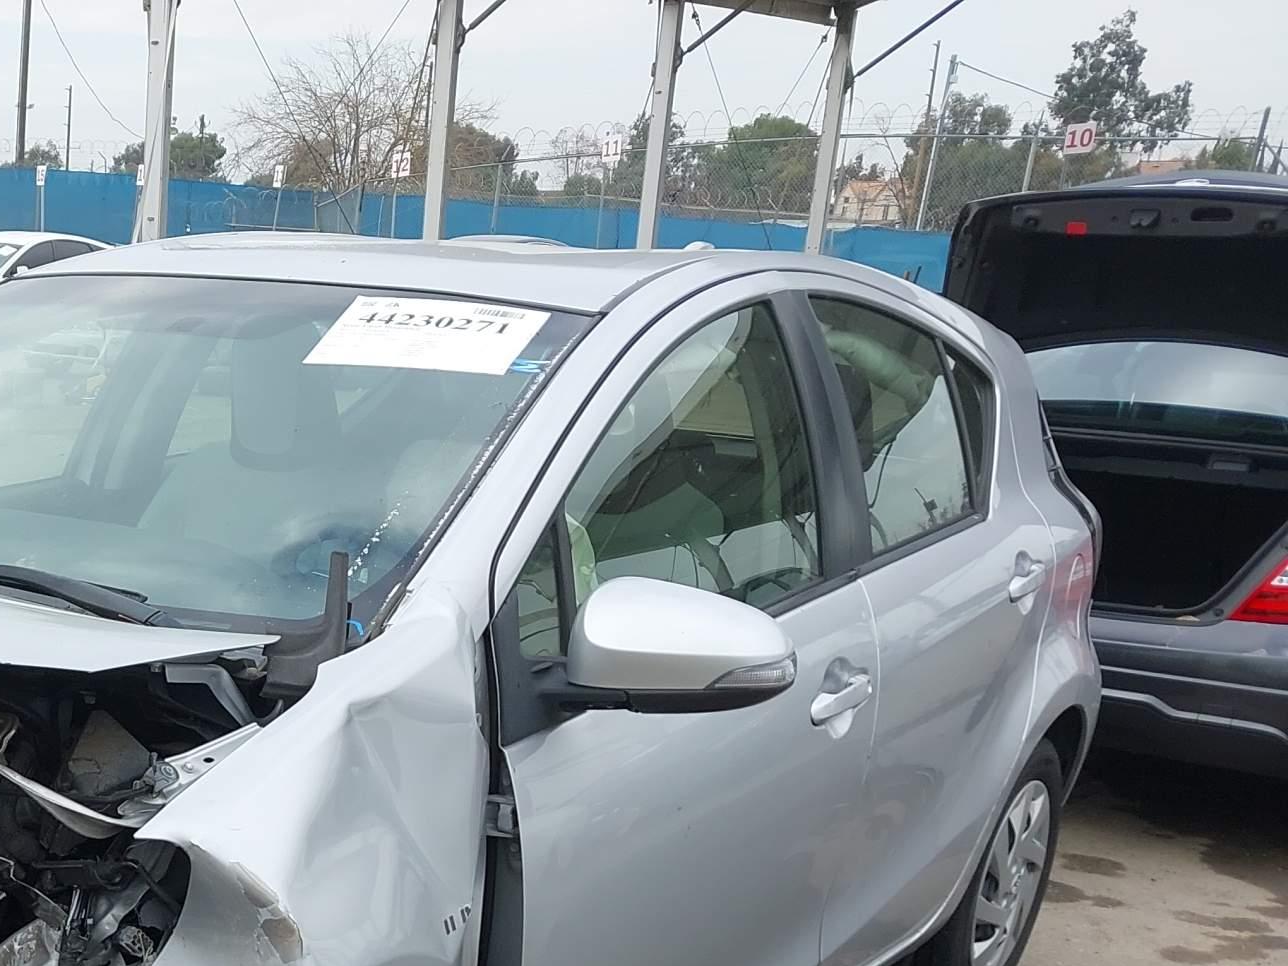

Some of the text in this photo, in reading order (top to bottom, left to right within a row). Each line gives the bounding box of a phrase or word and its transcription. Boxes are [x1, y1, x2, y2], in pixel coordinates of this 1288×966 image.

[1066, 127, 1094, 149] 10
[603, 139, 620, 158] 11
[393, 157, 410, 174] 12
[358, 311, 511, 335] 44230271
